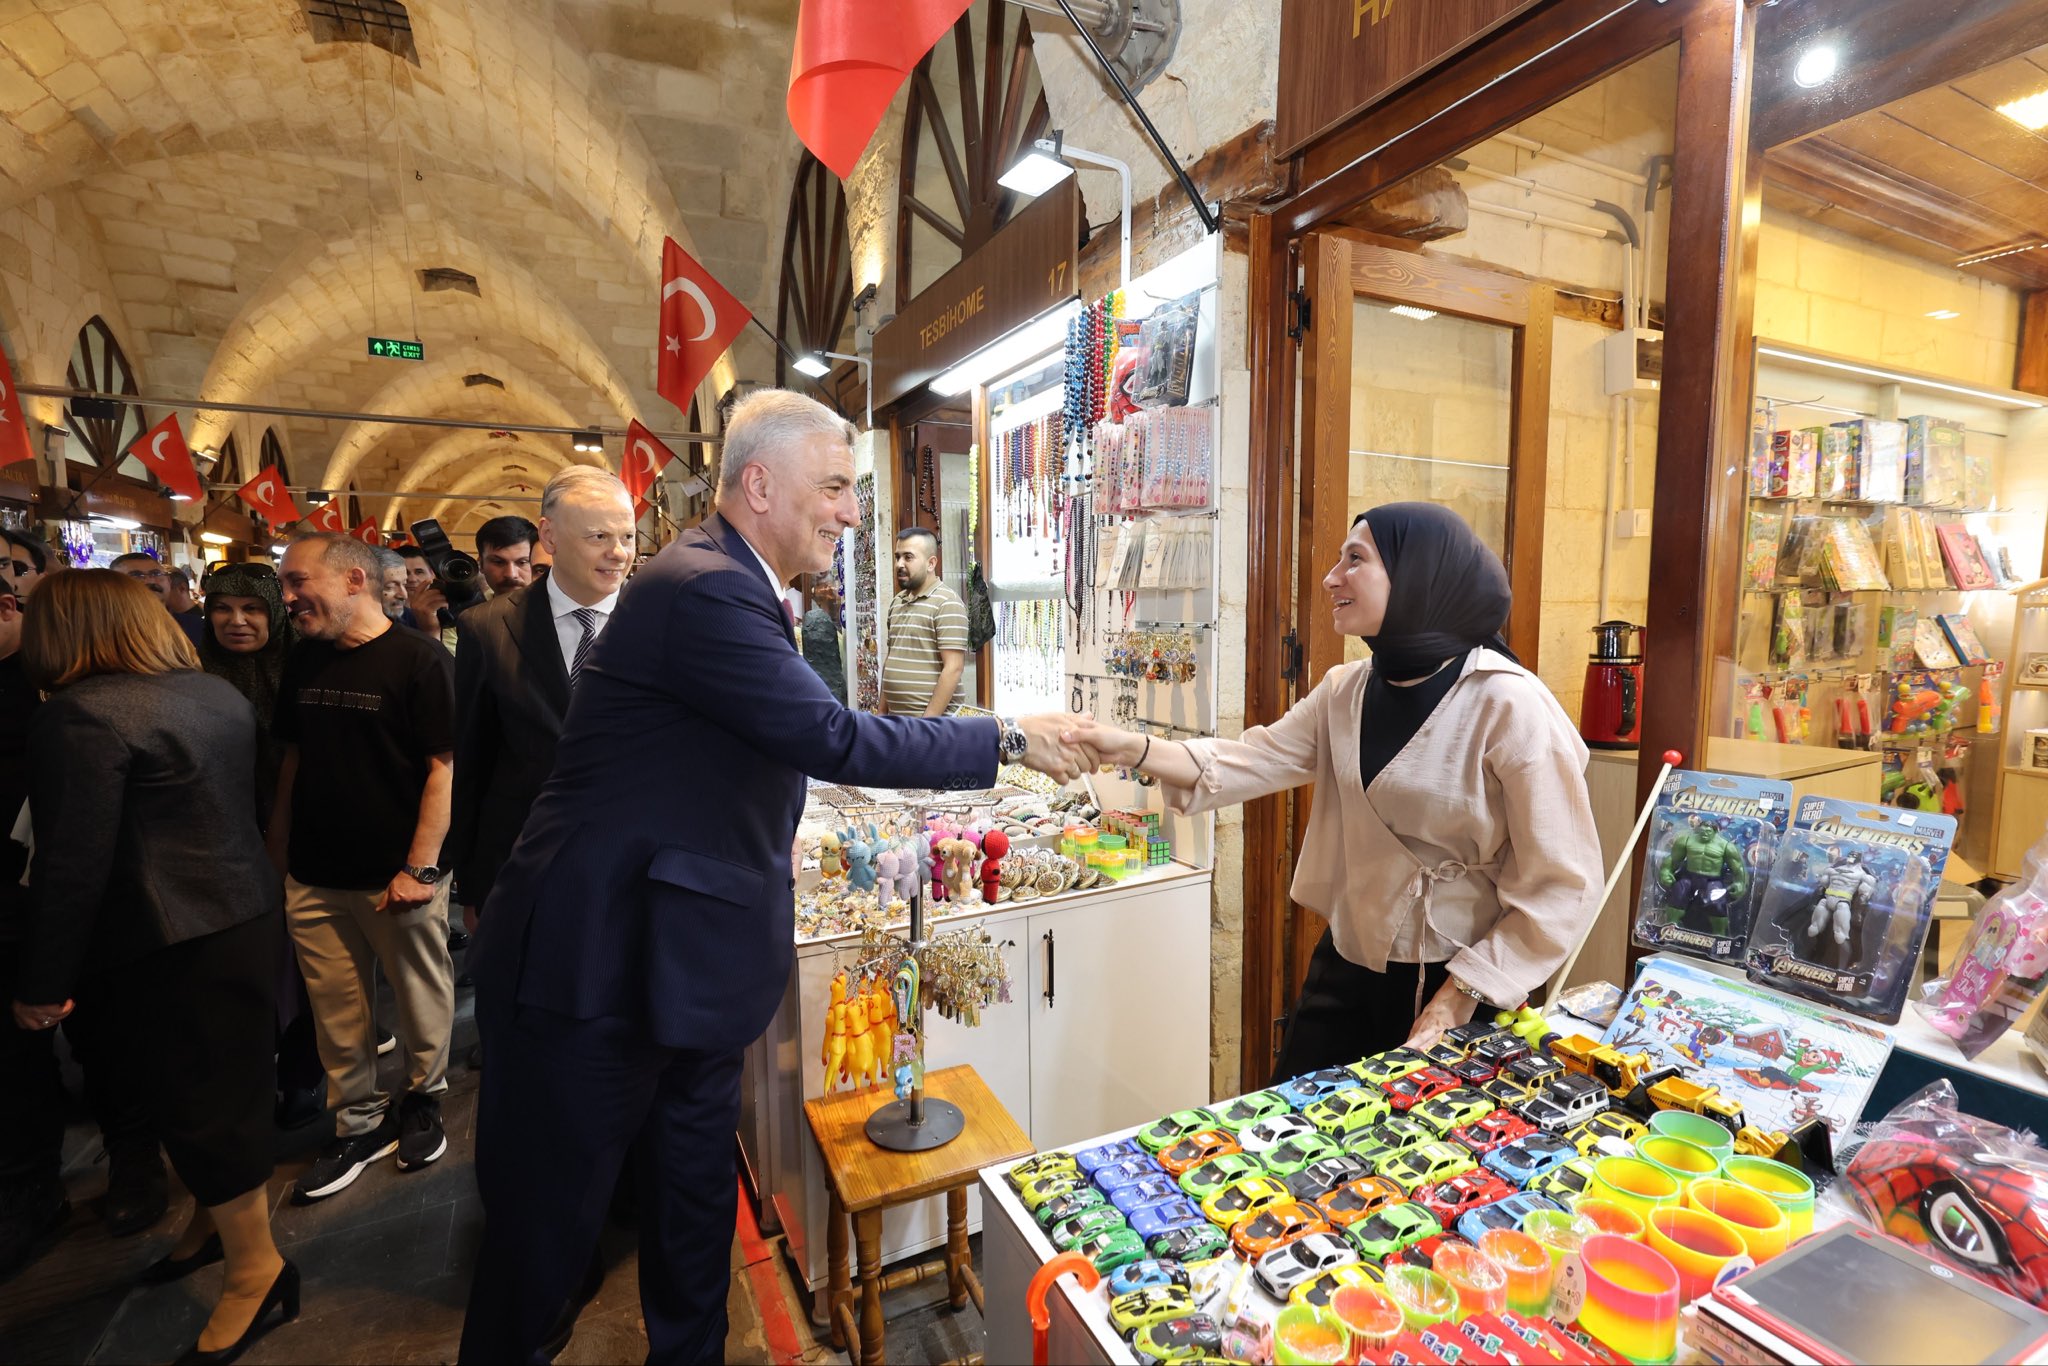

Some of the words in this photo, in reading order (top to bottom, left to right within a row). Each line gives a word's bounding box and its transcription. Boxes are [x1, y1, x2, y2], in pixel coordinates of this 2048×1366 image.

[919, 285, 985, 350] TESBİHOME
[1048, 260, 1067, 297] 17
[1662, 781, 1681, 793] HERO
[1671, 785, 1770, 818] AVENGERS
[1803, 801, 1826, 812] SUPER
[1801, 810, 1823, 821] HERO
[1810, 815, 1930, 854] AVENGERS
[1915, 826, 1944, 839] MARVEL
[1660, 925, 1717, 949] AVENGERS
[1716, 940, 1732, 948] SUPER
[1716, 946, 1731, 955] HERO
[1772, 955, 1837, 984] AVENGERS
[1837, 976, 1856, 984] SUPER
[1836, 983, 1854, 992] HERO
